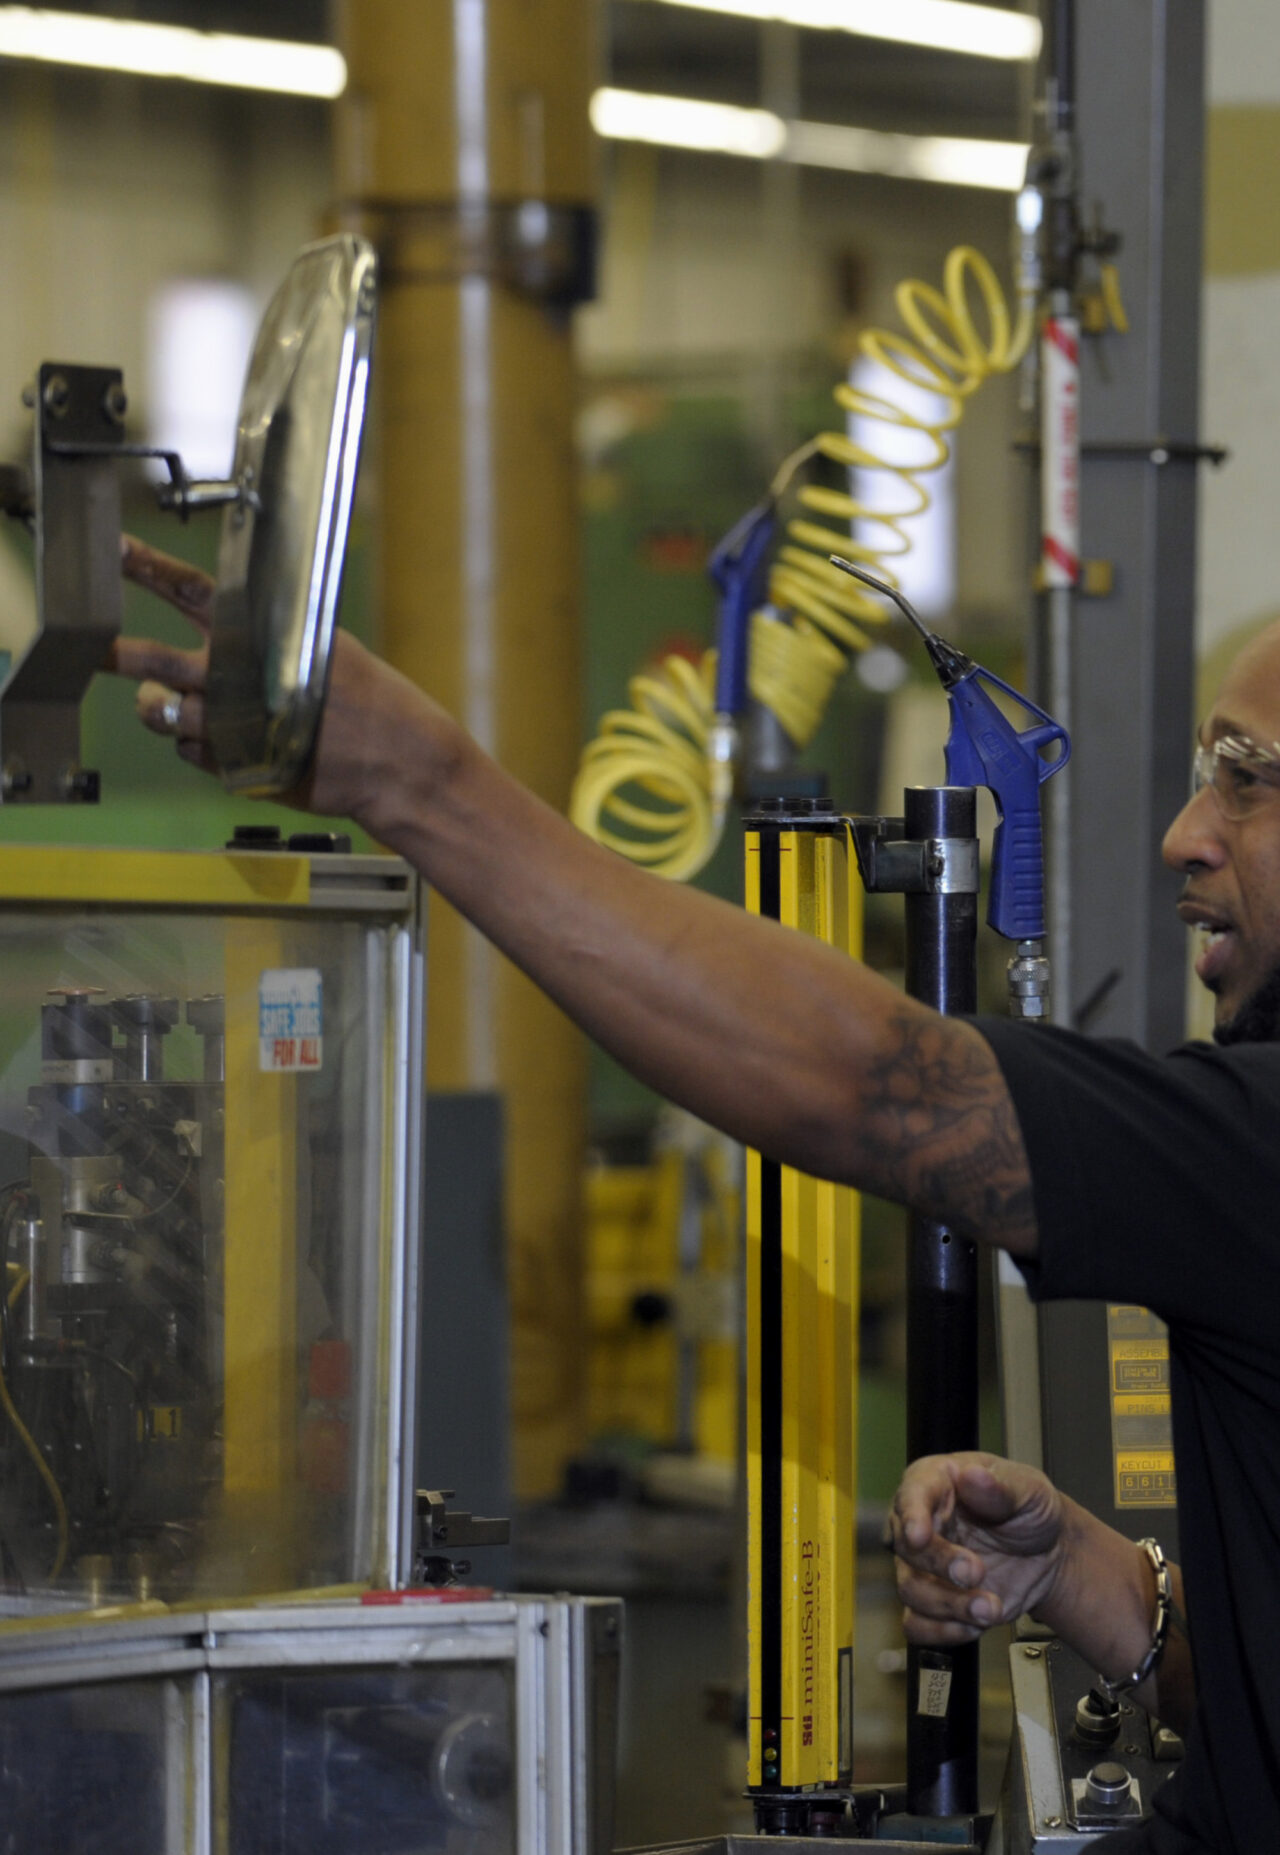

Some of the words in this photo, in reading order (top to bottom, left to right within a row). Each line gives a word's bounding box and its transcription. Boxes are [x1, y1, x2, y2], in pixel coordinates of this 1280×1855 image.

[273, 1039, 296, 1067] FOR
[299, 1039, 319, 1066] ALL
[802, 1540, 814, 1704] miniSafe-B
